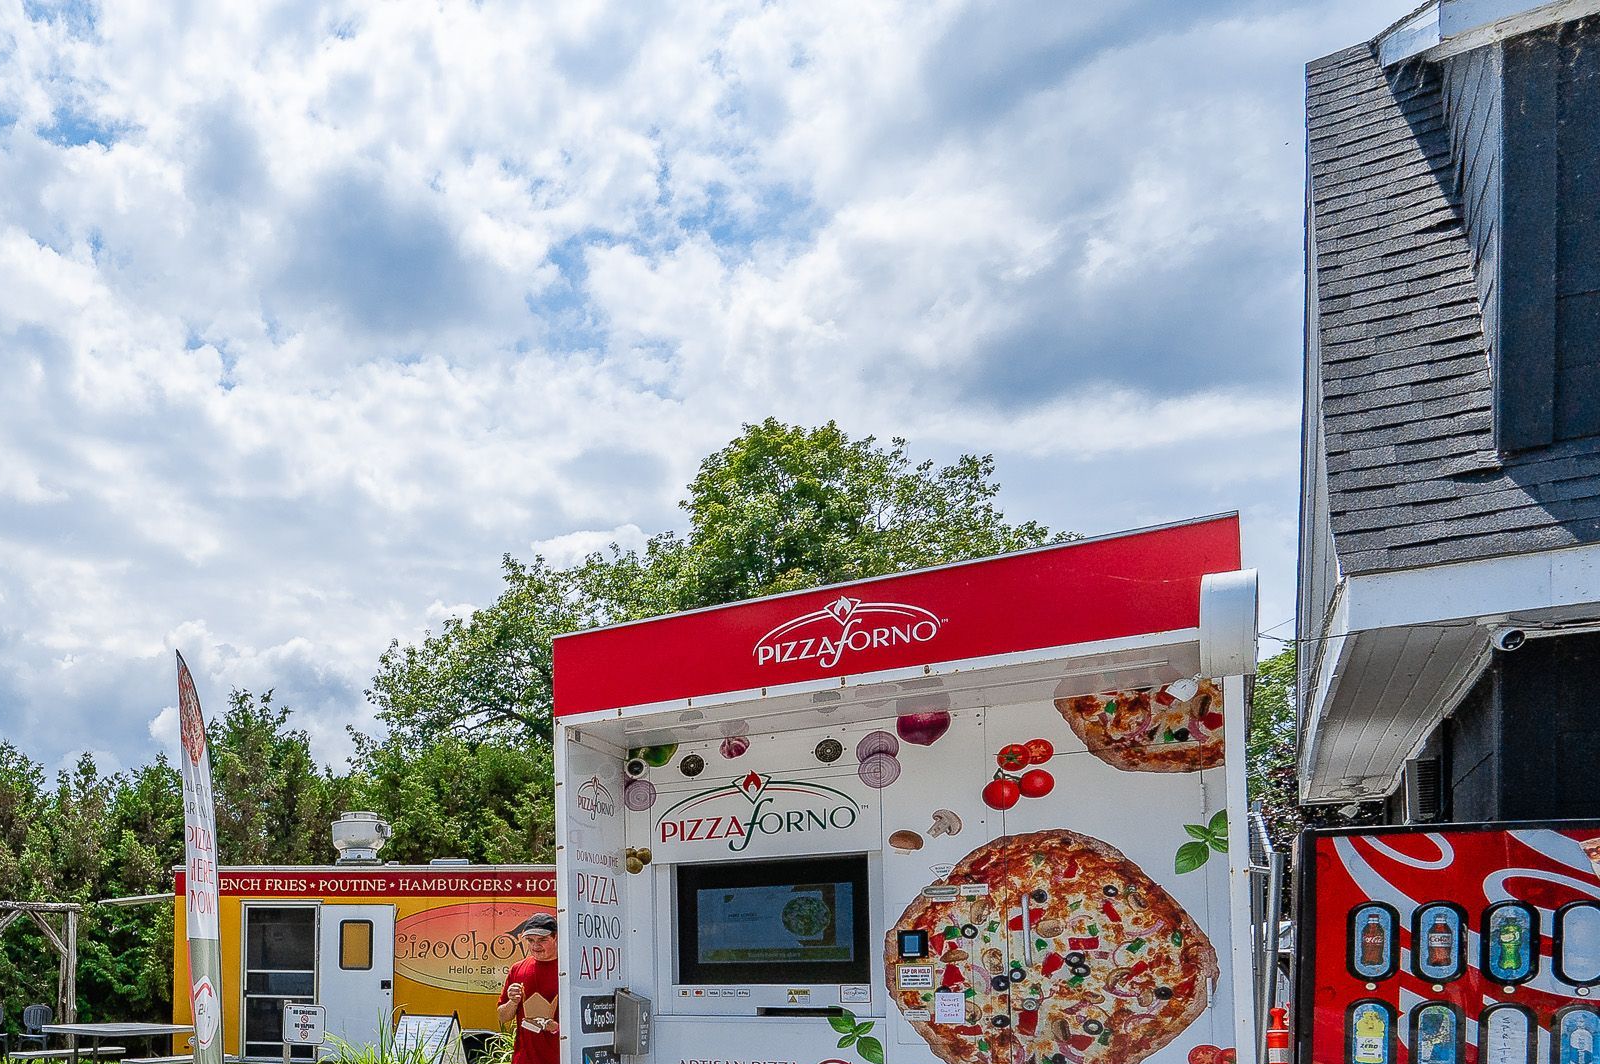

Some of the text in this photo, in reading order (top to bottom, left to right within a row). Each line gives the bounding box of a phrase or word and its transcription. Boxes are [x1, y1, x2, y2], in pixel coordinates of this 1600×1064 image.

[576, 849, 619, 868] DOWNLOAD THE
[219, 878, 556, 893] ENCH FRIES POUTINE HAMBURGERS HOT
[576, 872, 619, 906] PIZZA
[577, 912, 621, 940] FORNO
[448, 965, 474, 975] Hello
[480, 965, 496, 975] Eat
[579, 945, 622, 981] APP!
[593, 1011, 615, 1028] App Sto
